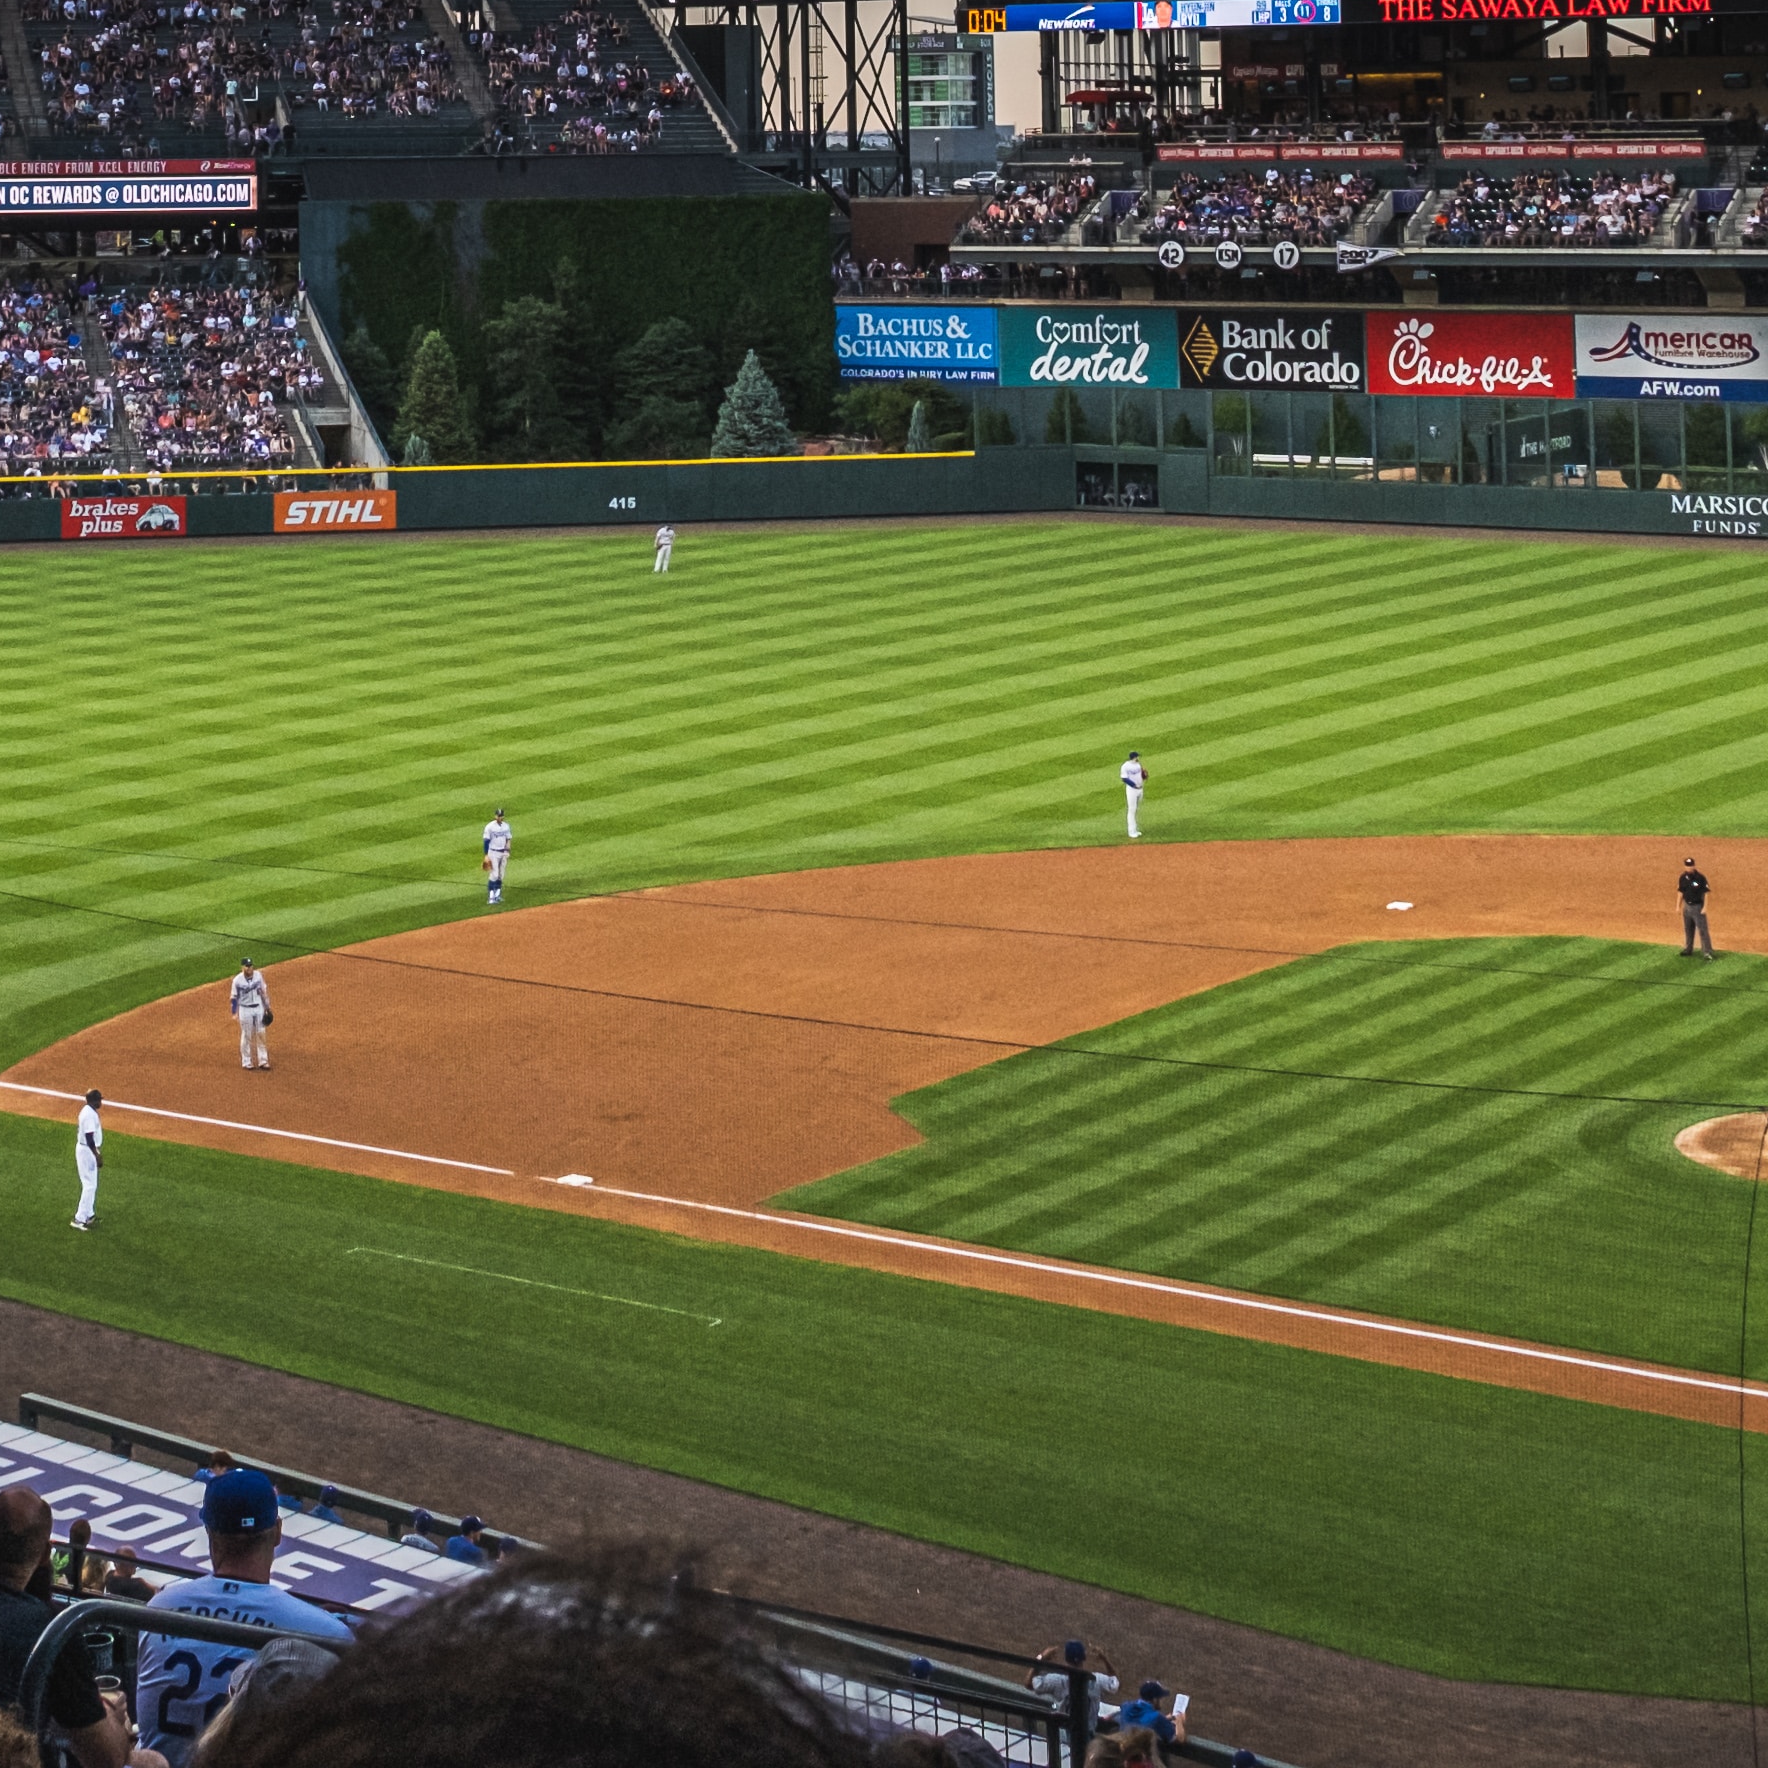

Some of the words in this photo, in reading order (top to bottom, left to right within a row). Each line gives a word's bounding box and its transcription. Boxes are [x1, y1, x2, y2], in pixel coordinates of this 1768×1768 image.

[968, 8, 1007, 33] 0:04
[1379, 0, 1432, 22] THE
[1038, 18, 1095, 30] NEWMONT
[985, 54, 994, 121] STORAGE
[22, 162, 60, 174] ENERGY
[65, 162, 93, 173] FROM
[99, 161, 124, 173] XCEL
[128, 161, 166, 173] ENERGY
[9, 185, 29, 205] OC
[33, 184, 101, 204] REWARDS
[106, 188, 119, 204] @
[122, 183, 248, 203] OLDCHICAGO.COM
[1161, 249, 1179, 265] 42
[1279, 248, 1294, 265] 17
[1339, 250, 1378, 259] 2007
[857, 313, 943, 337] BACHUS
[946, 315, 972, 339] &
[1036, 315, 1142, 344] Comfort
[1222, 318, 1296, 350] Bank
[1301, 319, 1331, 350] of
[1628, 322, 1753, 349] American
[838, 335, 951, 359] SCHANKER
[957, 343, 992, 359] LLC
[1030, 341, 1150, 384] dental
[1223, 351, 1360, 383] Colorado
[1389, 333, 1553, 392] Chick-fil-A
[841, 368, 904, 380] COLORADO'S
[946, 370, 968, 380] LAW
[971, 370, 995, 380] FIRM
[1640, 381, 1720, 397] AFW.com
[70, 498, 139, 517] brakes
[284, 500, 382, 525] STIHL
[609, 497, 637, 510] 415
[81, 518, 123, 535] plus
[1693, 520, 1759, 534] FUNDS
